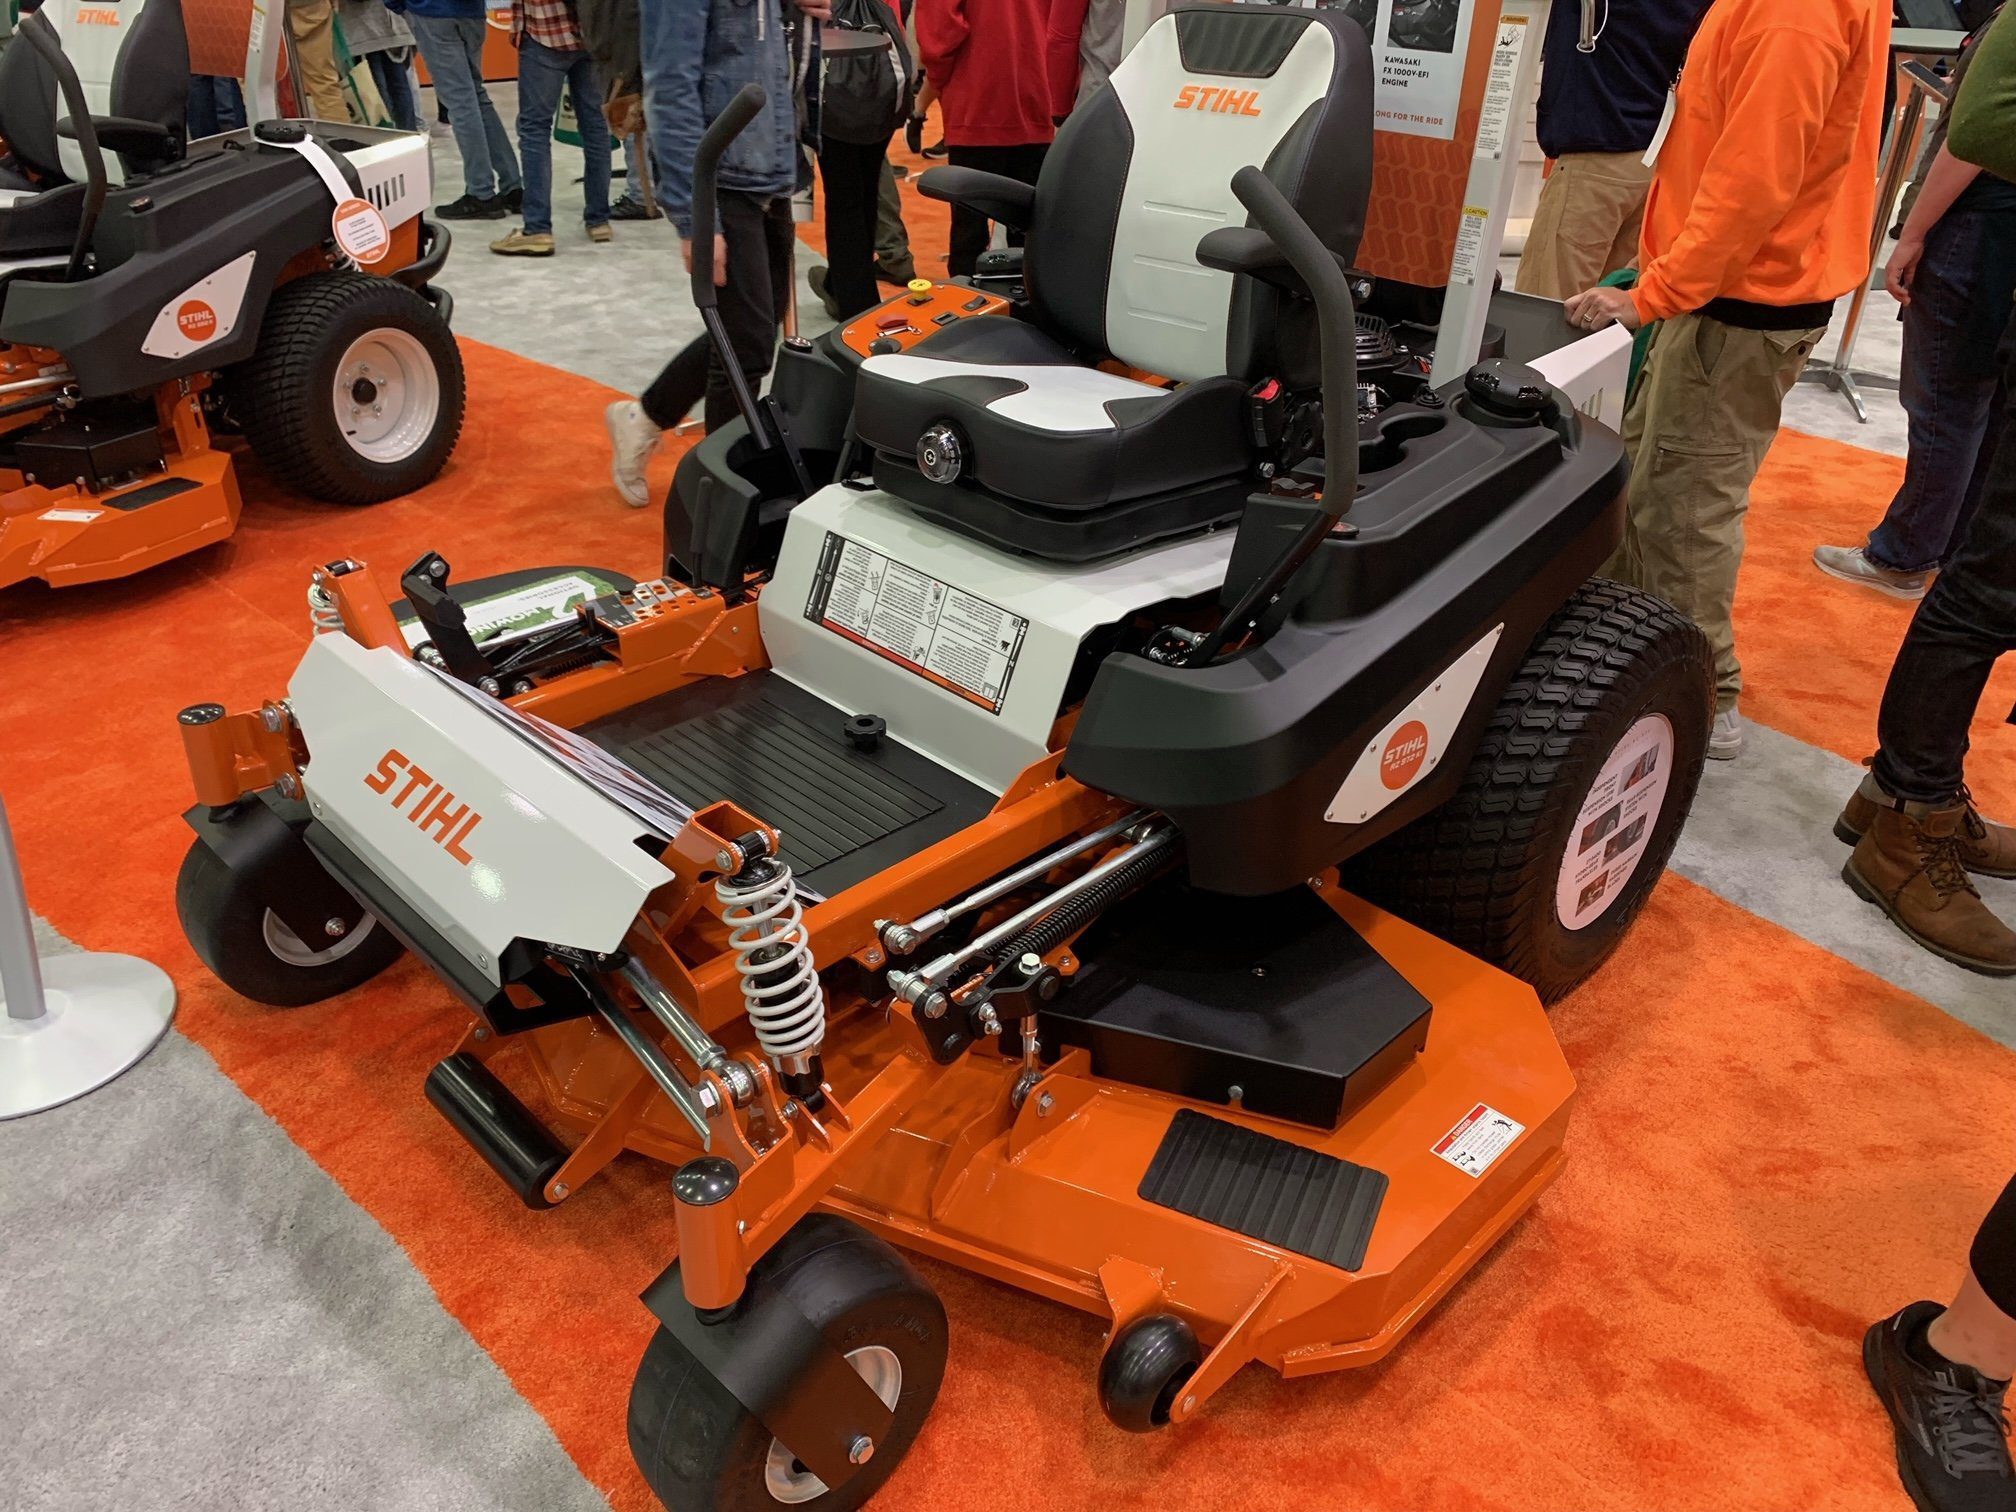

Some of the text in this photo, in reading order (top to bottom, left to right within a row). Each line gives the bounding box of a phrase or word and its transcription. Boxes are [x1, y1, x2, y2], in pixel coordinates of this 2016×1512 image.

[76, 9, 120, 26] STIHL
[1384, 56, 1421, 66] KAWASAKI
[1383, 67, 1429, 79] FX 1000V-EFI
[1381, 78, 1408, 87] ENGINE
[1173, 85, 1261, 117] STIHL
[1375, 110, 1391, 118] ONG
[1393, 112, 1408, 120] FOR
[1426, 117, 1443, 125] RIDE
[1468, 208, 1488, 216] CAUTION
[180, 310, 214, 326] STIHL
[1384, 735, 1425, 765] STIHL
[1389, 760, 1400, 772] RZ
[1400, 753, 1416, 766] 972
[363, 748, 483, 867] STIHL
[1453, 1118, 1473, 1137] DANGER
